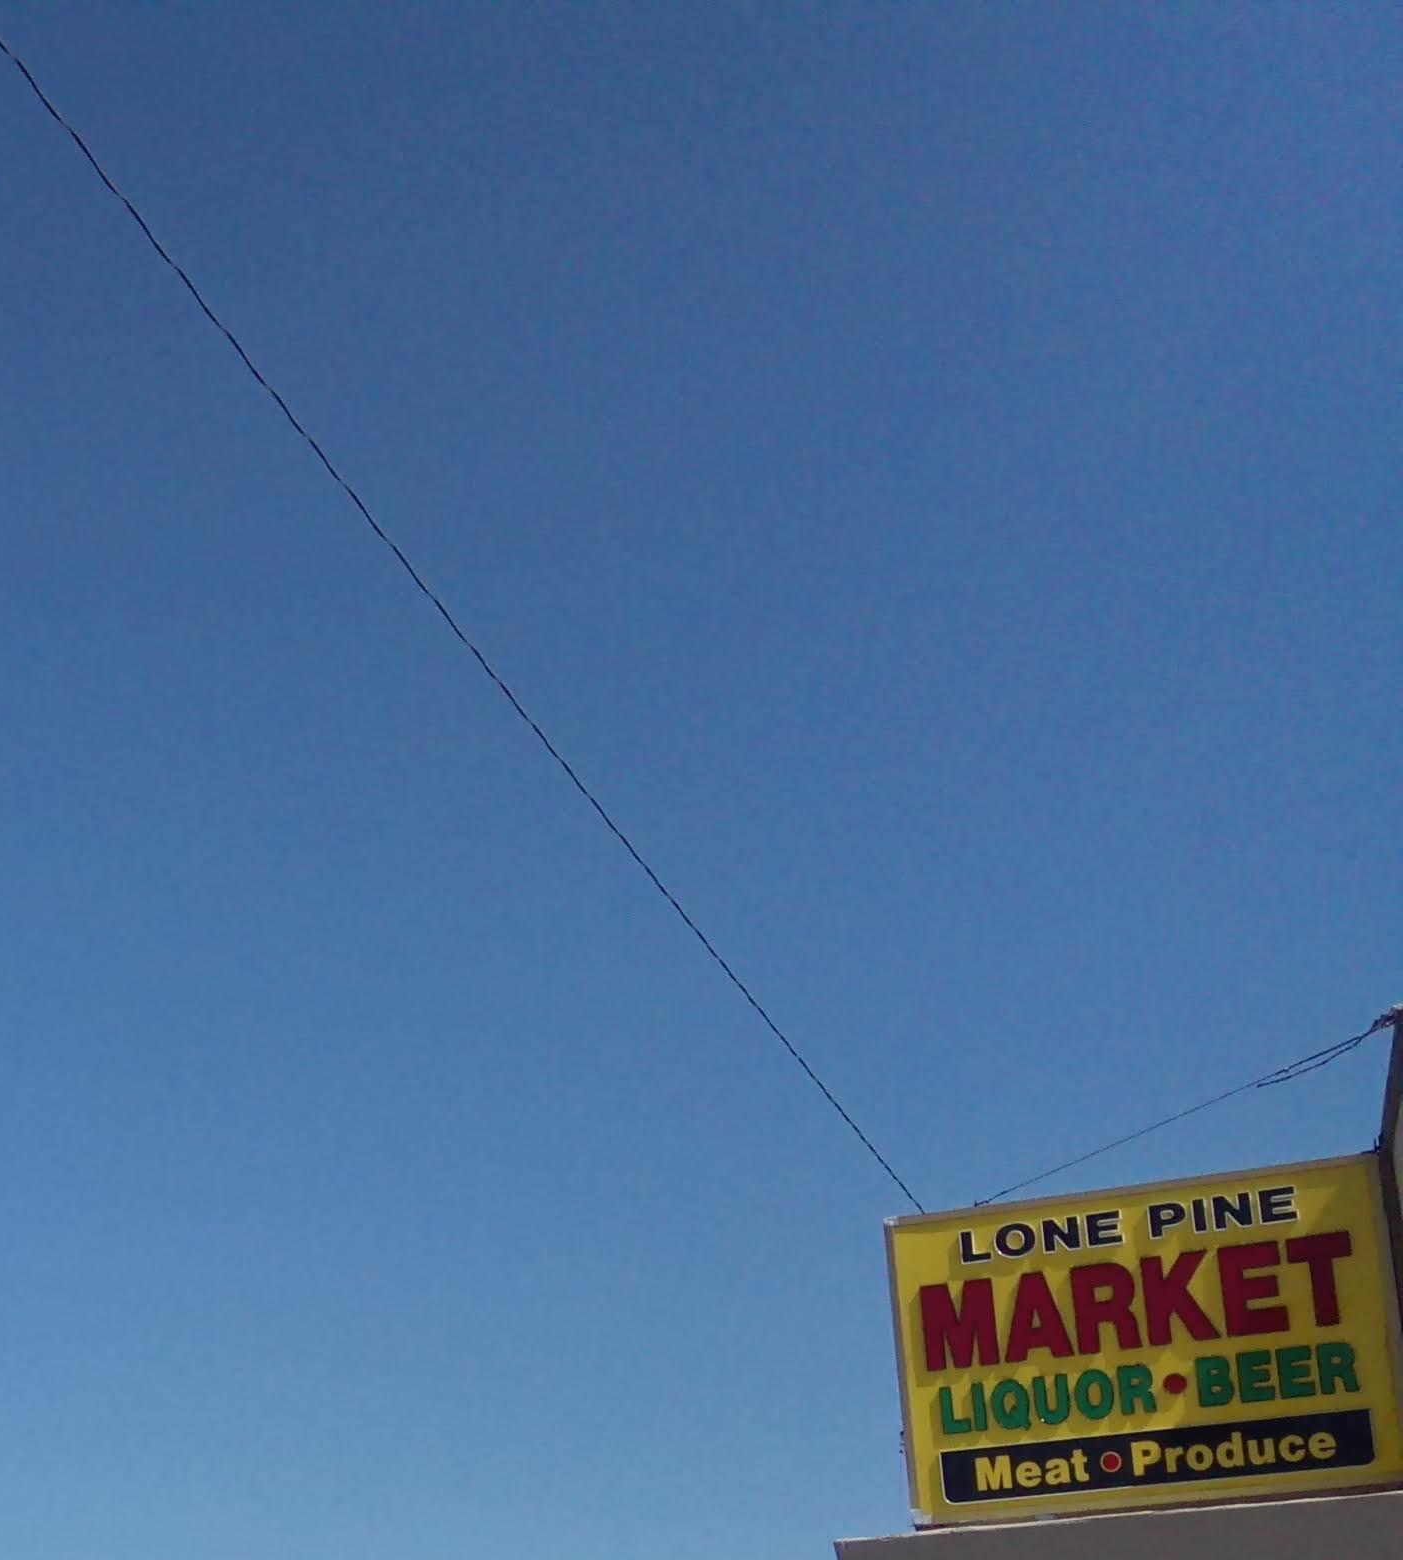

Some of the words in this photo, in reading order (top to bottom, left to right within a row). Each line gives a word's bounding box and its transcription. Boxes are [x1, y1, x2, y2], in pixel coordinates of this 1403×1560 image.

[959, 1210, 1124, 1265] LONE
[1147, 1186, 1298, 1239] PINE
[918, 1231, 1352, 1372] MARKET
[939, 1364, 1157, 1435] LIQUOR
[1194, 1341, 1360, 1408] BEER
[975, 1449, 1090, 1492] Meat
[1130, 1430, 1337, 1476] Produce
